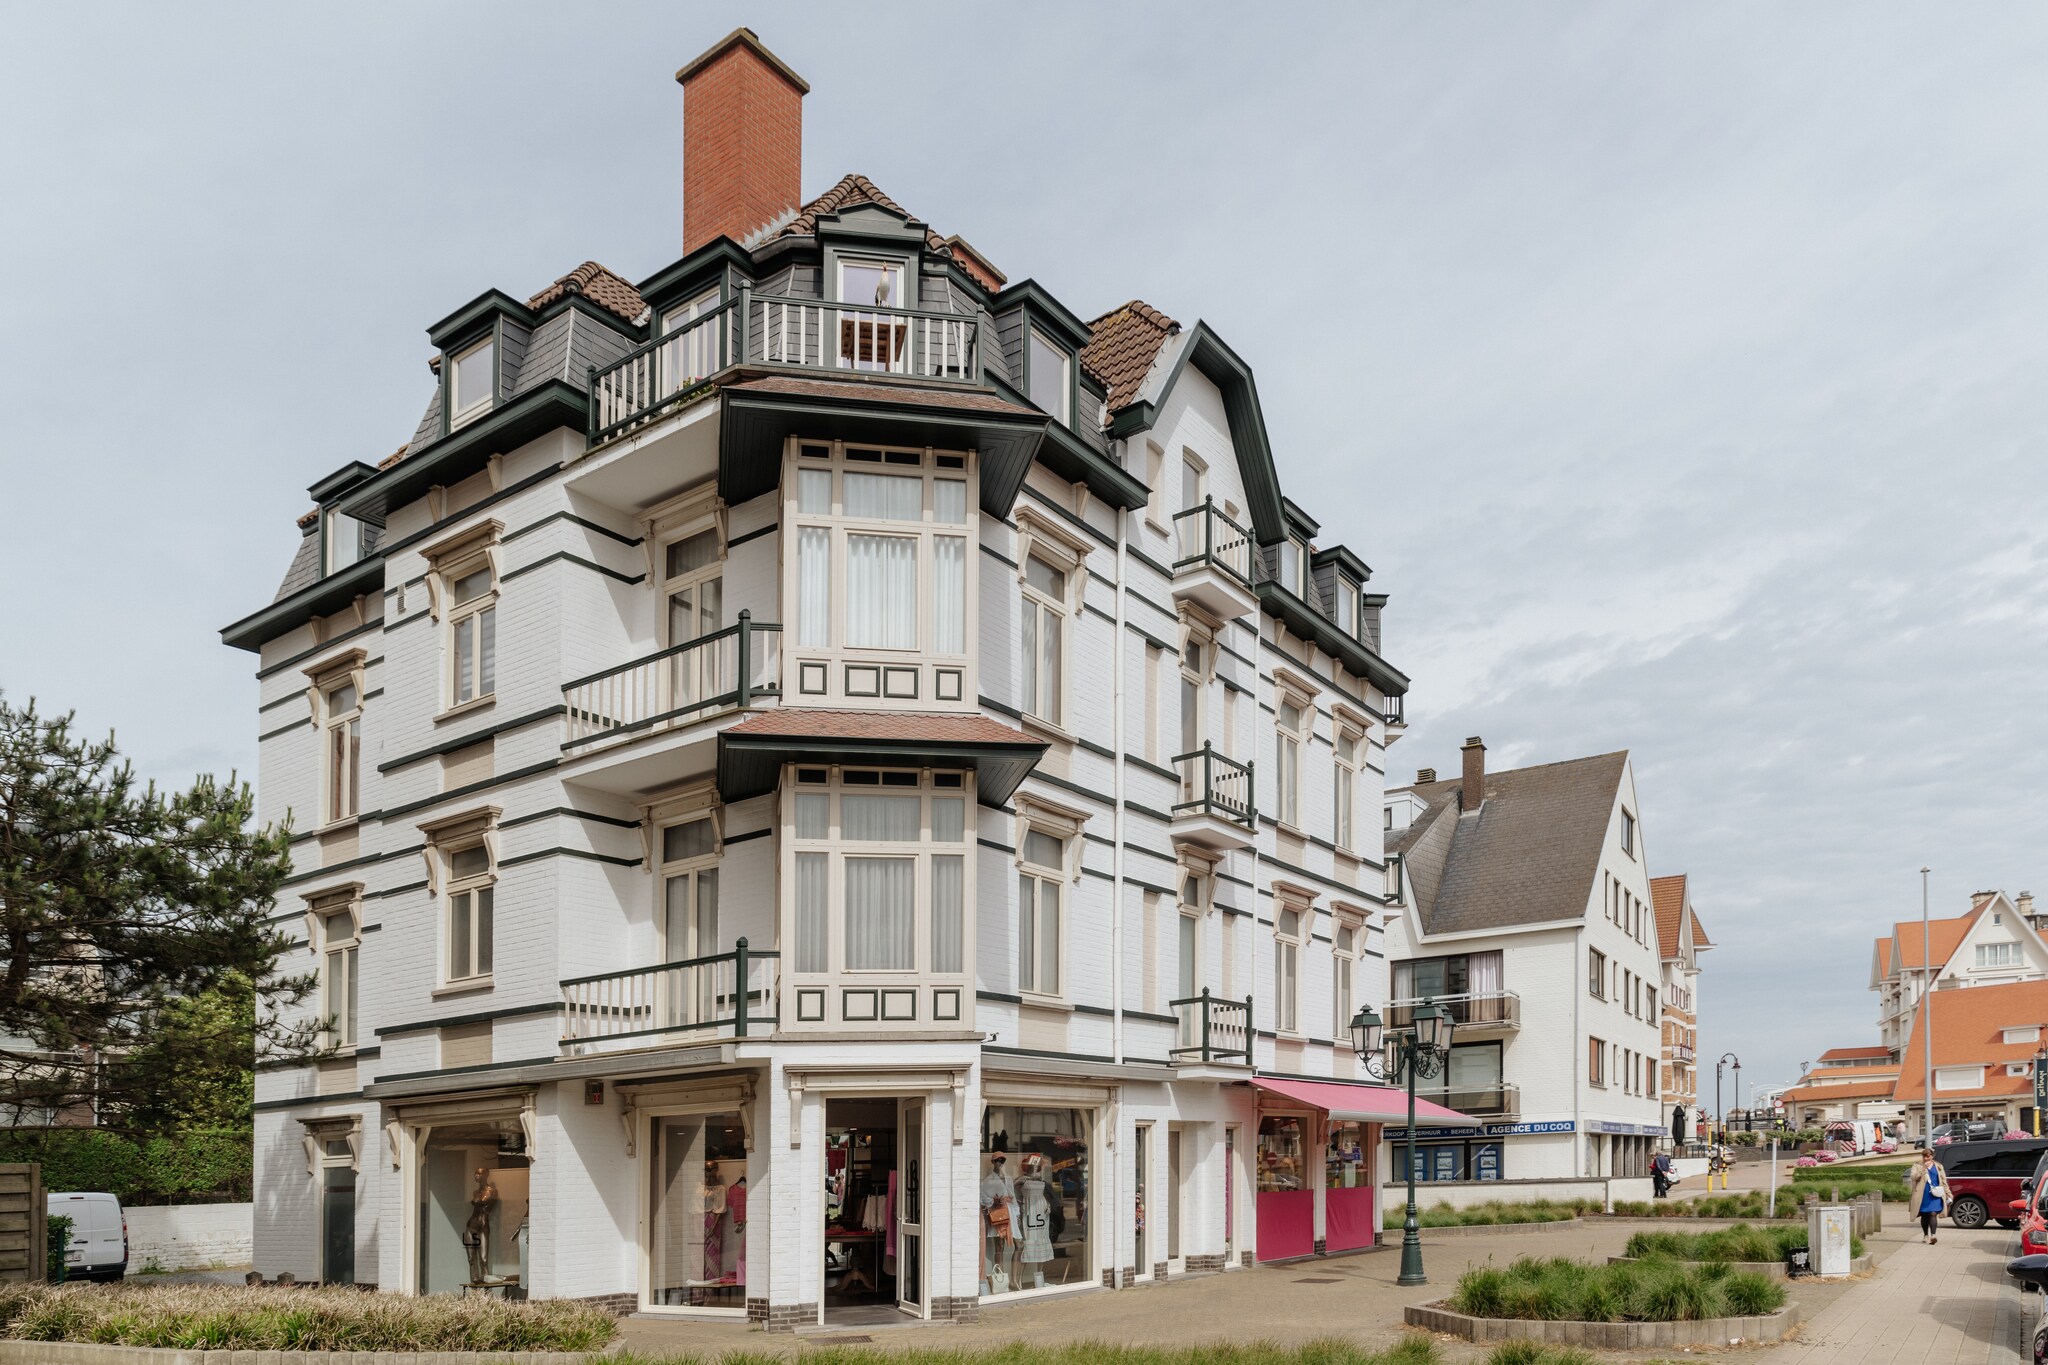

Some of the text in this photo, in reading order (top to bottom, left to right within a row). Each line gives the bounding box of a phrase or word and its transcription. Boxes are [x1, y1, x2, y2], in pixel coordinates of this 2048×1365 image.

[1415, 1129, 1441, 1137] VERHUUR
[1490, 1122, 1572, 1134] AGENCE DU COQ
[1026, 1213, 1046, 1228] LS
[462, 1232, 482, 1246] LS
